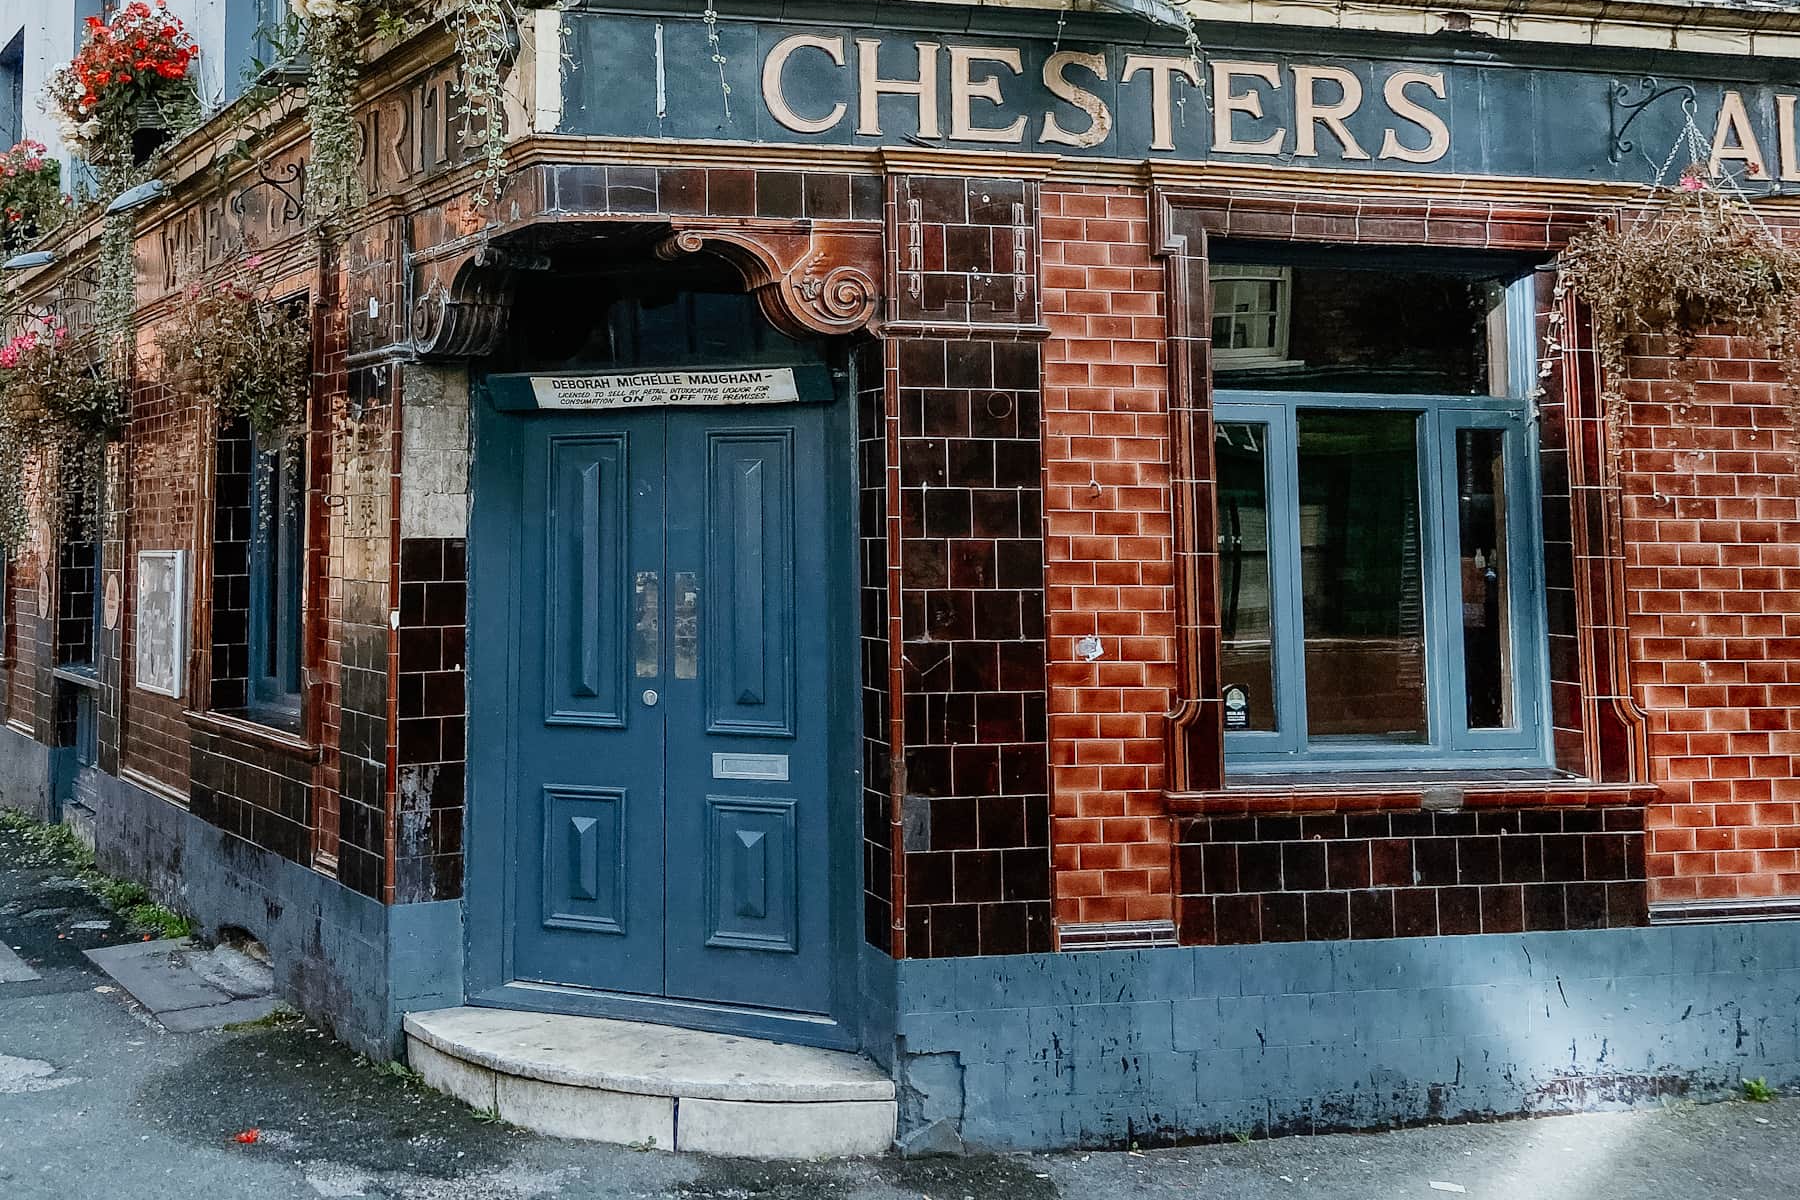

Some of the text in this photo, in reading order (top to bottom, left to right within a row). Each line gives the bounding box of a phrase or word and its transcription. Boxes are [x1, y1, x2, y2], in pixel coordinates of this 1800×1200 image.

[761, 33, 1451, 165] CHESTERS
[552, 378, 611, 390] DEBORAH
[616, 374, 683, 388] MICHELLE
[688, 372, 763, 386] MAUGHAM
[558, 391, 591, 399] LICENSED
[629, 388, 641, 396] BY
[643, 387, 668, 395] RETAIL
[670, 386, 719, 395] INTOXICATING
[722, 386, 752, 394] LIQUOR
[754, 385, 770, 393] FOR
[560, 397, 616, 405] CONSUMPTION
[622, 395, 645, 403] ON
[650, 394, 663, 402] OR
[703, 393, 720, 401] THE
